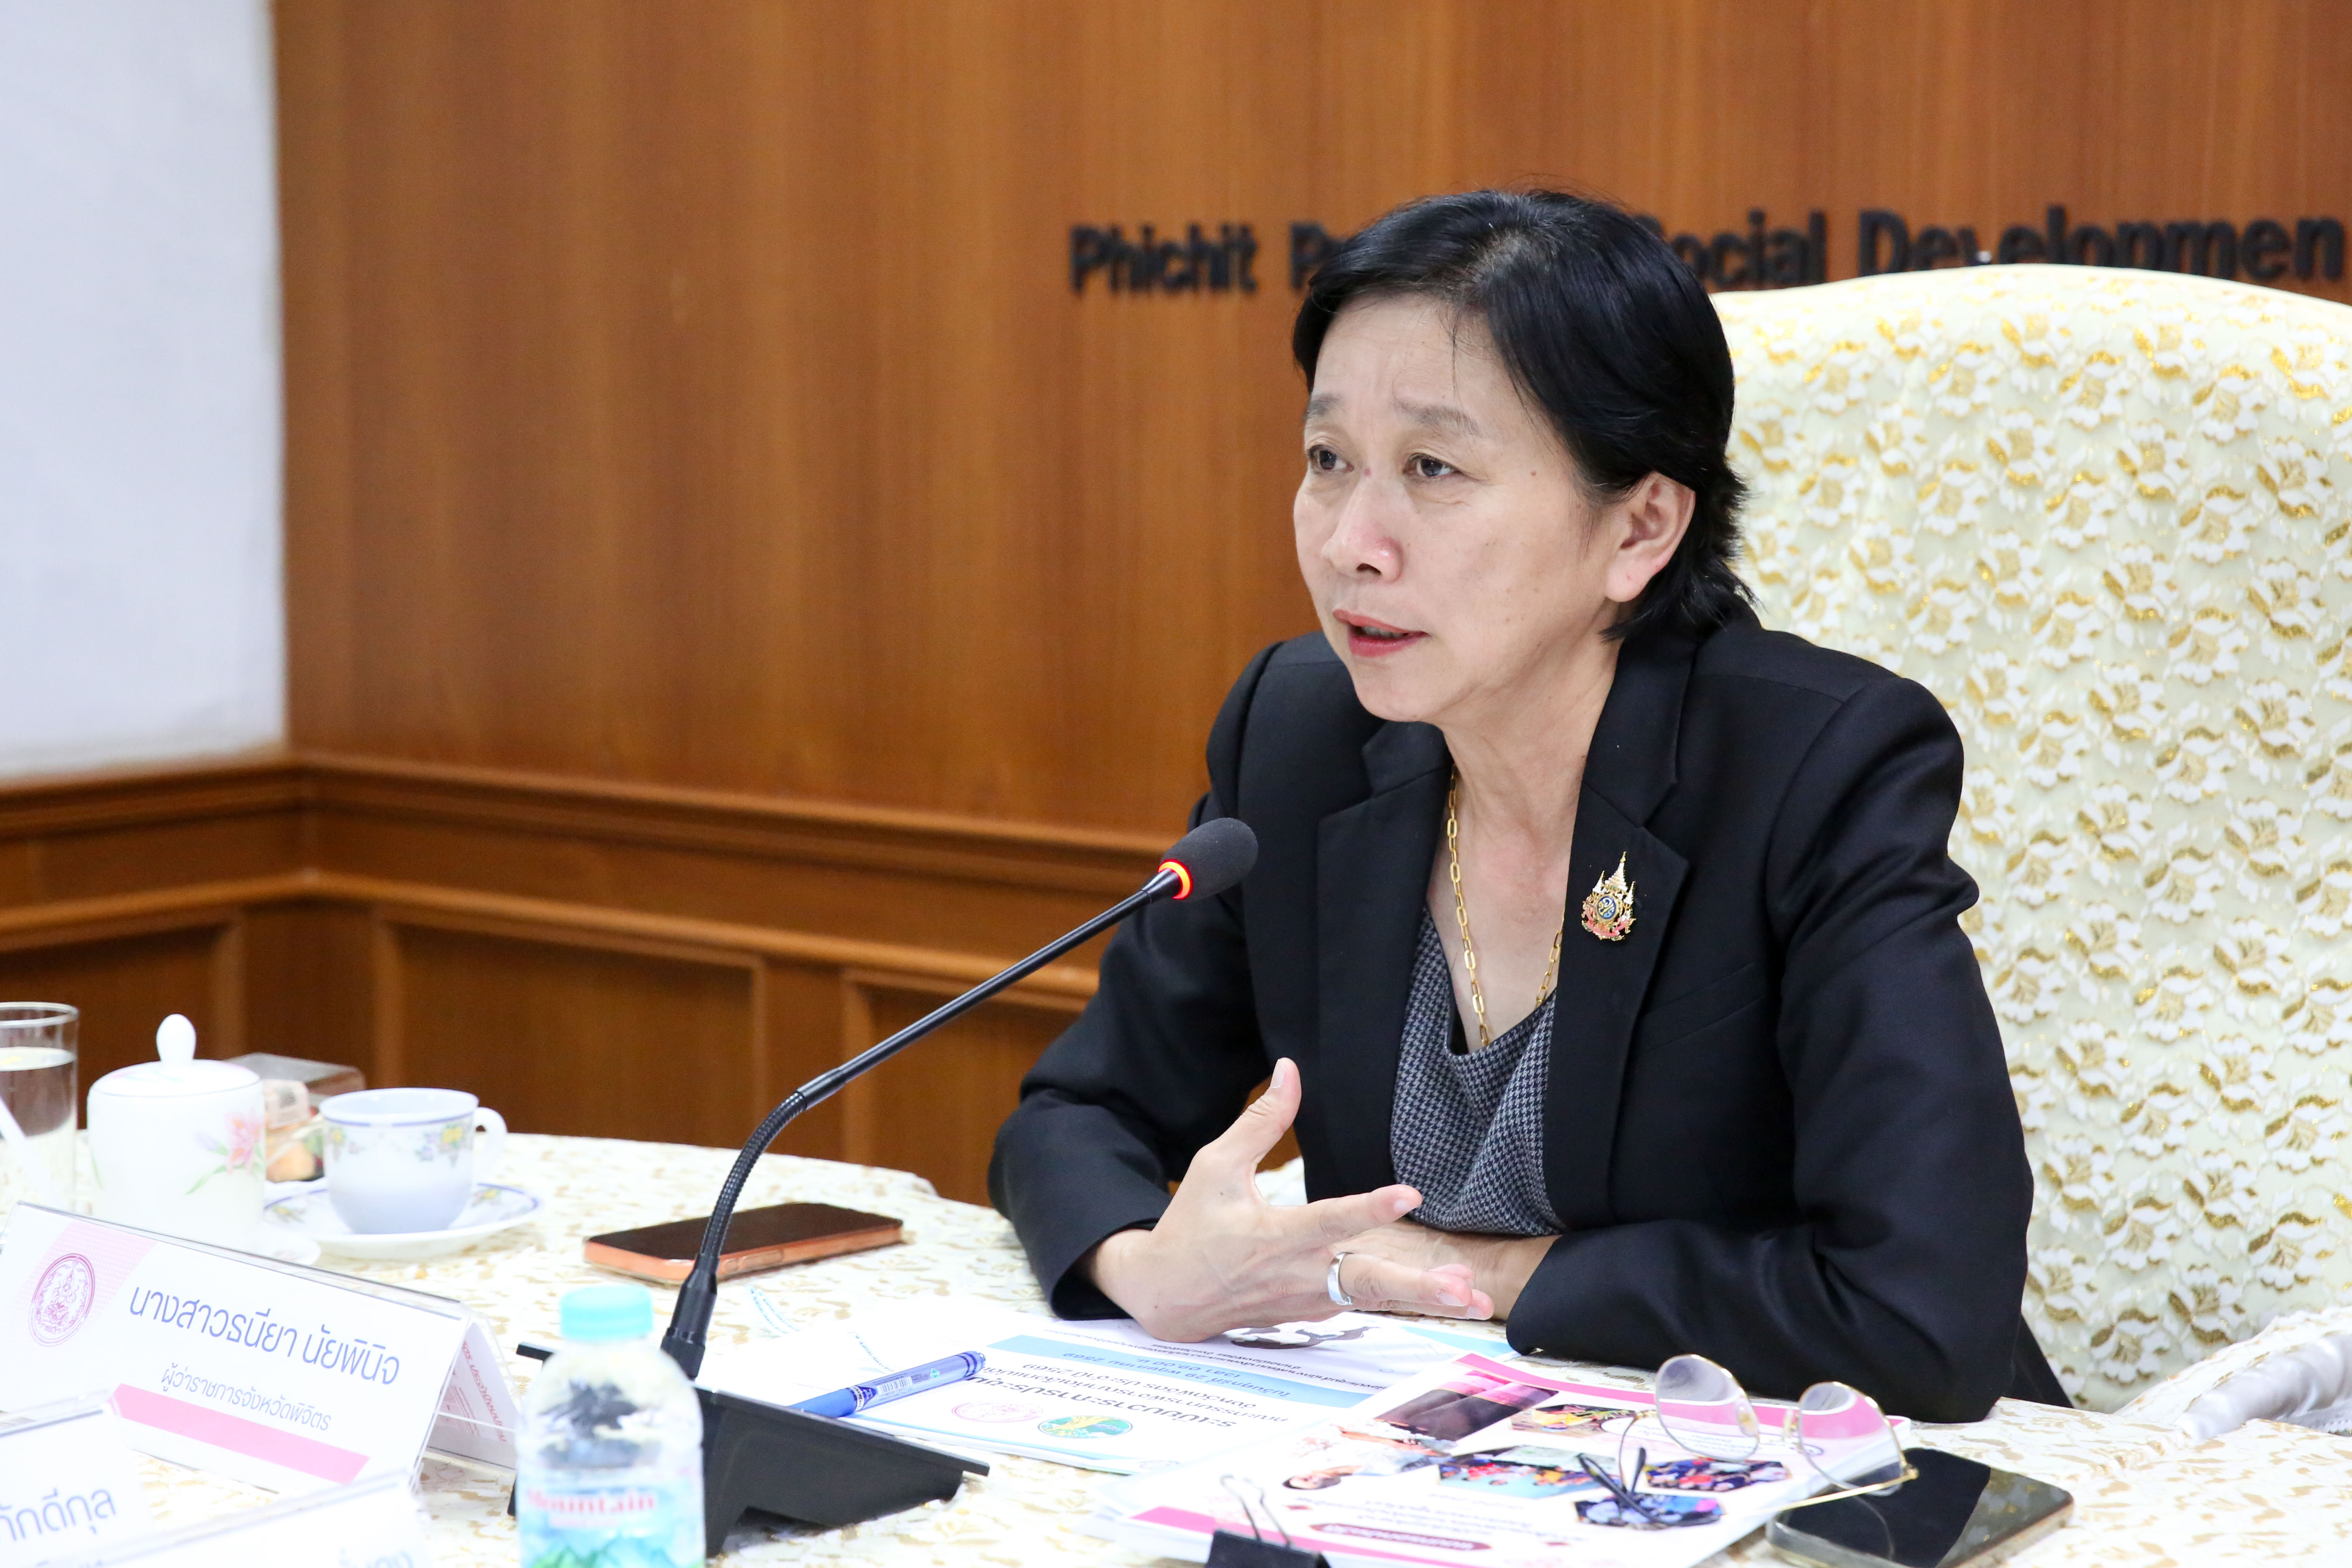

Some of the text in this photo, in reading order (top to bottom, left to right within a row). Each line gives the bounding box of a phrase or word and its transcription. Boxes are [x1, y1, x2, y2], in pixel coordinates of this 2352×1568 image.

[1070, 223, 1258, 293] Phichit
[129, 1286, 400, 1385] นางสาวธนียา นัยพินิจ
[1062, 1352, 1106, 1363] 2569
[1022, 1363, 1257, 1409] จังหวัดพิจิตร ประจำปี 2569
[1152, 1361, 1202, 1371] 09.00
[1205, 1368, 1241, 1379] เวลา
[161, 1362, 332, 1431] ผู้ว่าราชการจังหวัดพิจิตร
[983, 1367, 1289, 1422] คณะกรรมการพิจารณาคัดเลือกแม่ดีเ
